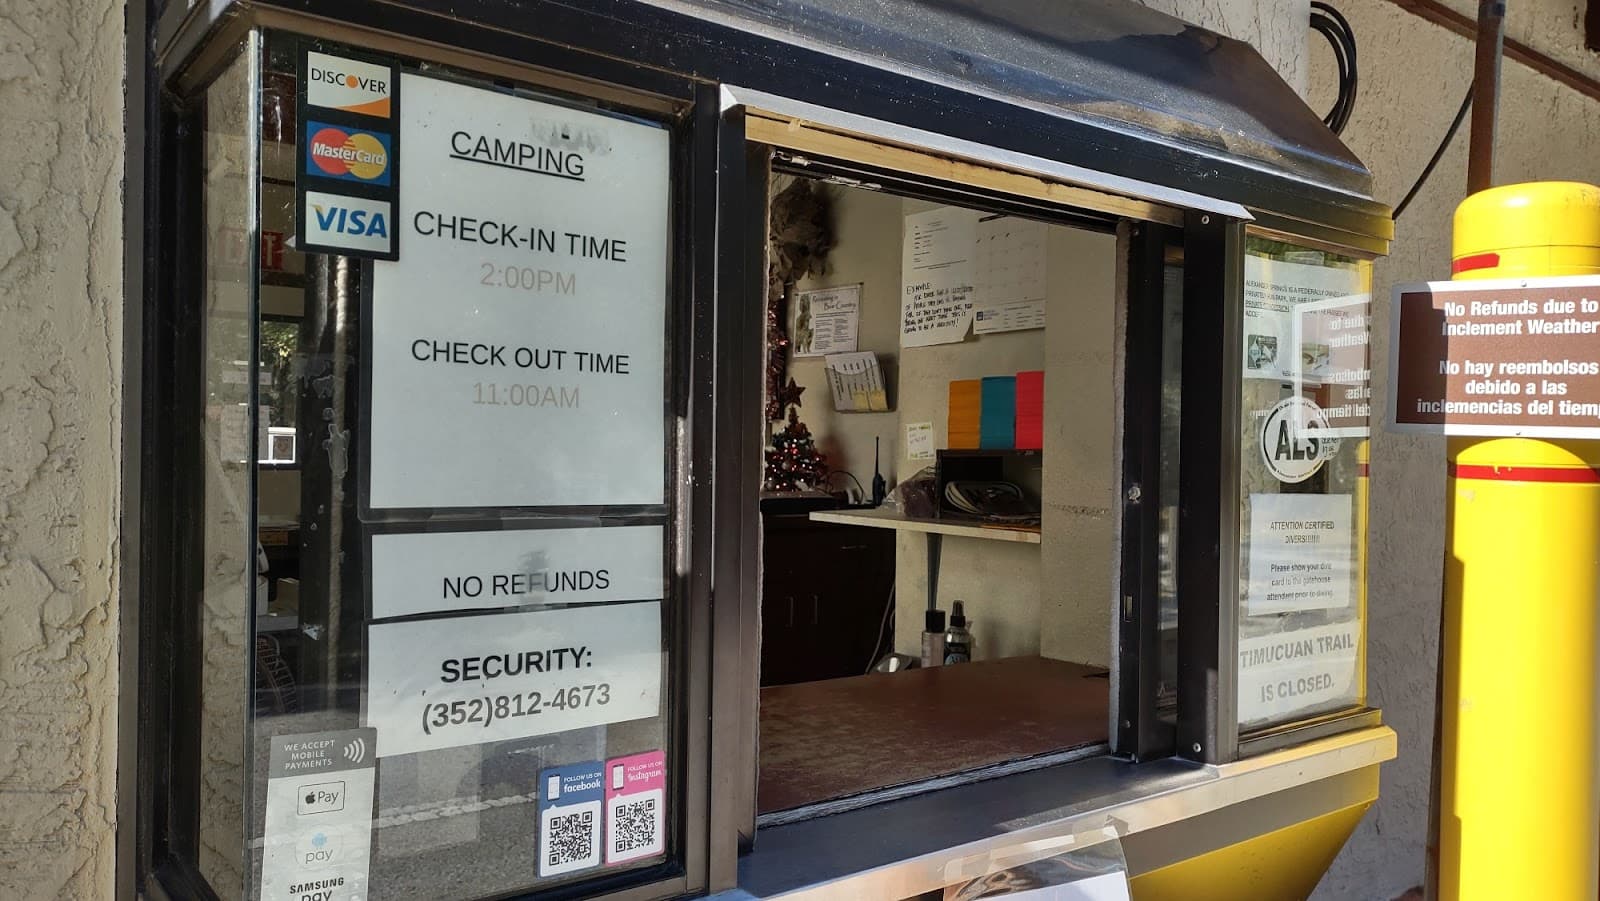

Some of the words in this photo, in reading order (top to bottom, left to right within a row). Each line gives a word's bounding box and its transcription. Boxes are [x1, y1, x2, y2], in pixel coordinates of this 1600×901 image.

[311, 67, 387, 95] DISCOVER
[312, 141, 386, 165] MasterCard
[450, 130, 586, 179] CAMPING
[311, 204, 388, 239] VISA
[413, 210, 556, 254] CHECK-IN
[564, 232, 628, 262] TIME
[480, 262, 576, 296] 2:00PM
[1444, 302, 1465, 317] No
[1471, 300, 1537, 317] Refunds
[1543, 299, 1575, 314] due
[1581, 298, 1599, 313] to
[1442, 320, 1522, 336] Inclement
[1527, 319, 1600, 335] Weather
[411, 339, 507, 367] CHECK
[515, 347, 567, 370] OUT
[574, 352, 630, 375] TIME
[1439, 360, 1460, 375] No
[1465, 359, 1494, 378] hay
[1500, 359, 1599, 375] reembolsos
[472, 382, 581, 409] 11:00AM
[1465, 379, 1520, 395] debido
[1525, 382, 1536, 395] a
[1542, 379, 1568, 395] las
[1417, 398, 1522, 415] inclemencias
[1527, 399, 1553, 415] del
[1559, 399, 1600, 418] tiem
[1275, 419, 1319, 461] ALS
[1270, 521, 1303, 531] ATTENTION
[1304, 520, 1335, 530] CERTIFIED
[1270, 563, 1290, 573] Please
[1291, 563, 1306, 572] show
[1306, 563, 1319, 573] your
[442, 576, 484, 599] NO
[492, 569, 610, 597] REFUNDS
[1240, 639, 1313, 668] TIMUCUAN
[1317, 633, 1354, 655] TRAIL
[440, 646, 592, 684] SECURITY:
[1261, 684, 1274, 702] IS
[1277, 673, 1335, 698] CLOSED.
[422, 683, 611, 735] (352)812-4673
[284, 743, 299, 752] WE
[300, 740, 336, 750] ACCEPT
[291, 750, 325, 760] MOBILE
[284, 758, 333, 770] PAYMENTS
[655, 760, 663, 768] ON
[564, 774, 585, 783] FOLLOW
[586, 773, 593, 781] US
[594, 771, 602, 779] ON
[628, 769, 662, 782] Instagram
[564, 780, 602, 793] facebook
[317, 791, 340, 805] Pay
[305, 848, 334, 864] pay
[289, 877, 345, 895] SAMSUNG
